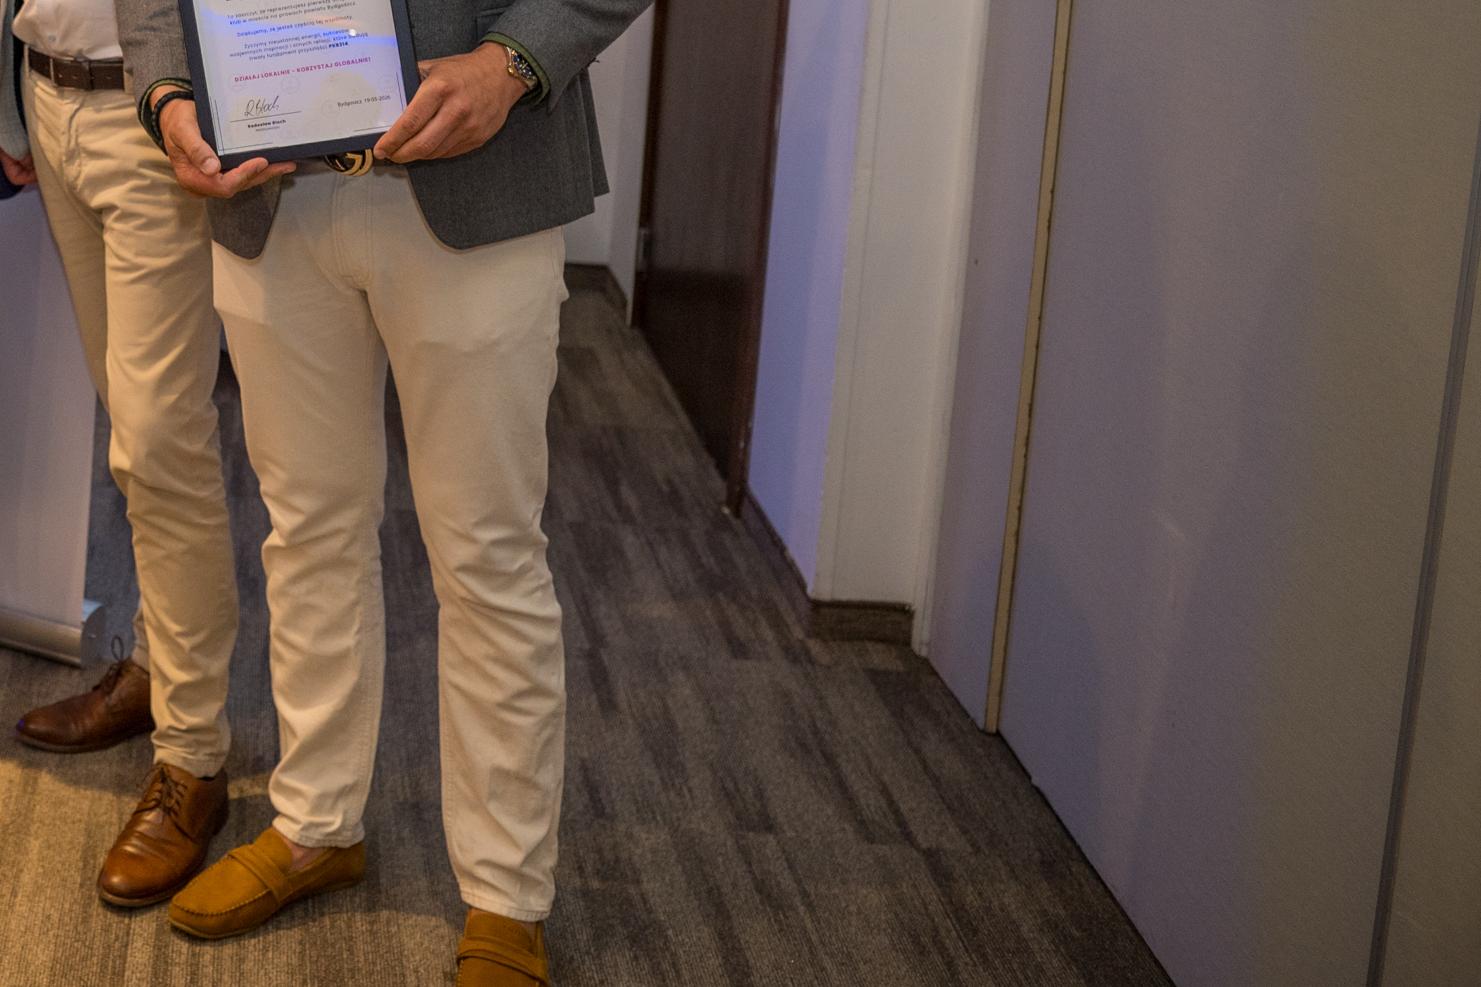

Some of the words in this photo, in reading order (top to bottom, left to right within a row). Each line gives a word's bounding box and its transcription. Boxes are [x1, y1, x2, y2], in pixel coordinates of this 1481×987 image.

[234, 74, 260, 83] DZIAŁAJ
[261, 69, 291, 79] LOKALNIE
[296, 62, 333, 73] KORZYSTAJ
[334, 57, 371, 68] GLOBALNIE!
